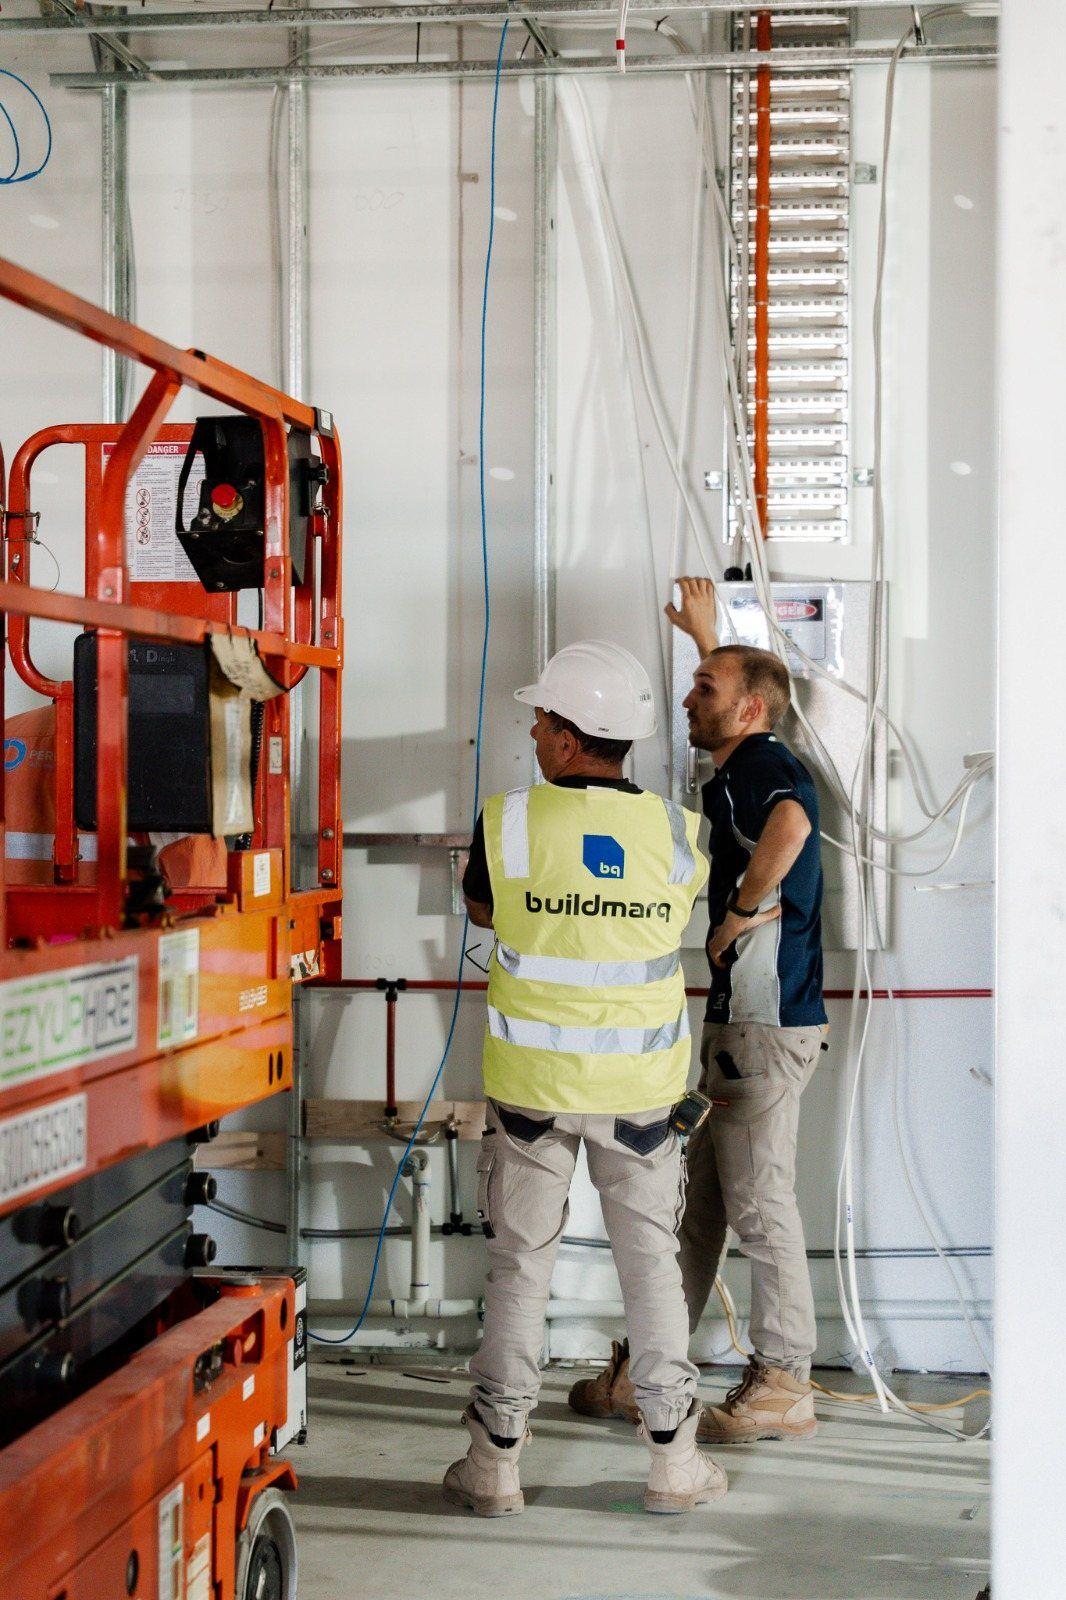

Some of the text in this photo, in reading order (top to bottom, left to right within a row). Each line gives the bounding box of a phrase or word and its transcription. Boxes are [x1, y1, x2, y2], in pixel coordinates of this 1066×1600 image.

[147, 445, 179, 454] DANGER
[599, 861, 621, 878] bq
[525, 891, 672, 923] buildmarq
